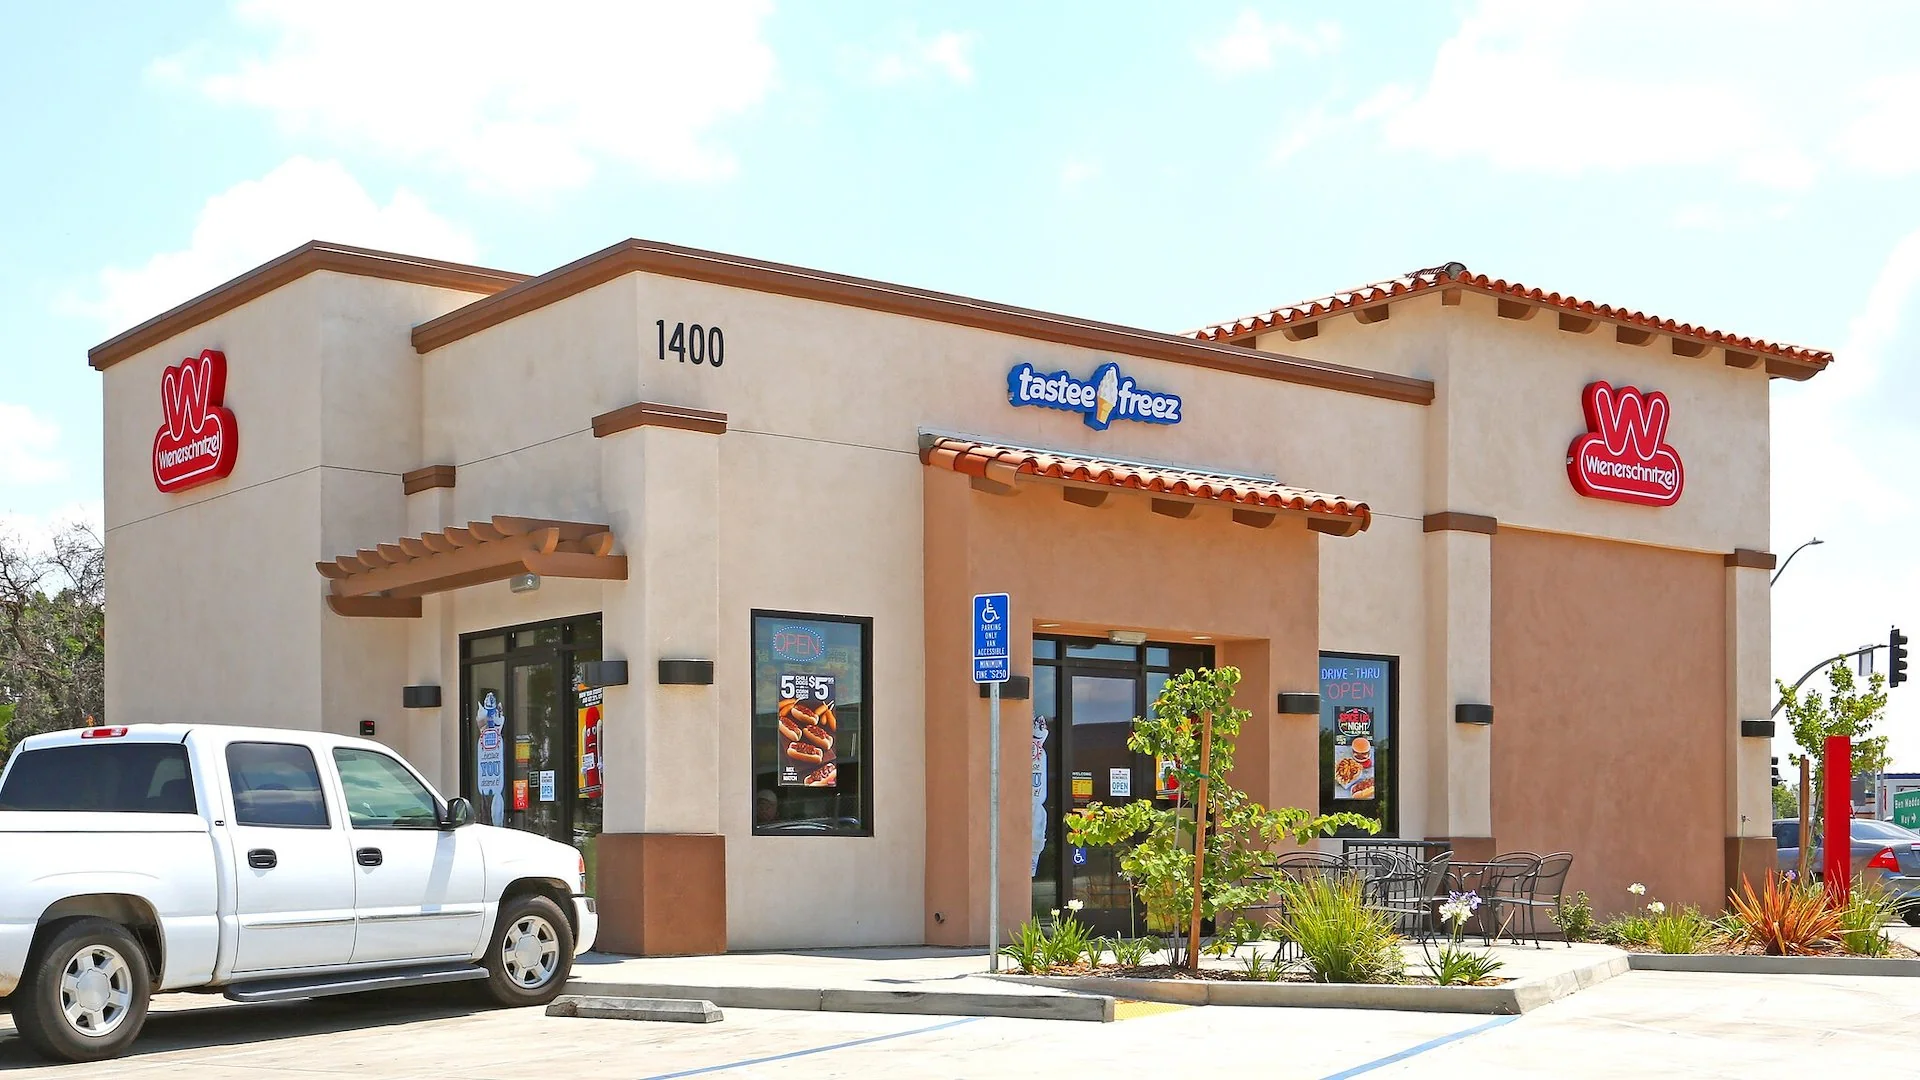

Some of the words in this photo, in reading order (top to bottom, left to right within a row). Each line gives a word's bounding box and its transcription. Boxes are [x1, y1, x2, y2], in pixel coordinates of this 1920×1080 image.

[656, 319, 724, 368] 1400
[164, 357, 211, 442] W
[1019, 367, 1096, 408] tastee
[1118, 381, 1178, 420] freez
[1595, 388, 1666, 462] W
[159, 431, 220, 469] Wienerschnitzel
[1586, 455, 1676, 490] Wienerschnitzel
[981, 623, 1001, 631] PARKING
[985, 632, 998, 640] ONLY
[775, 633, 819, 655] OPEN
[977, 647, 1005, 656] ACCESSIBLE
[979, 660, 1002, 668] MINIMUM
[976, 670, 988, 679] FINE
[781, 676, 795, 699] 5
[1328, 683, 1374, 699] OPEN
[1339, 713, 1358, 722] SPICE
[1360, 713, 1369, 722] UP
[1348, 722, 1368, 730] NIGHT
[481, 761, 501, 776] YOU
[541, 785, 553, 795] OPEN
[1112, 781, 1128, 790] OPEN
